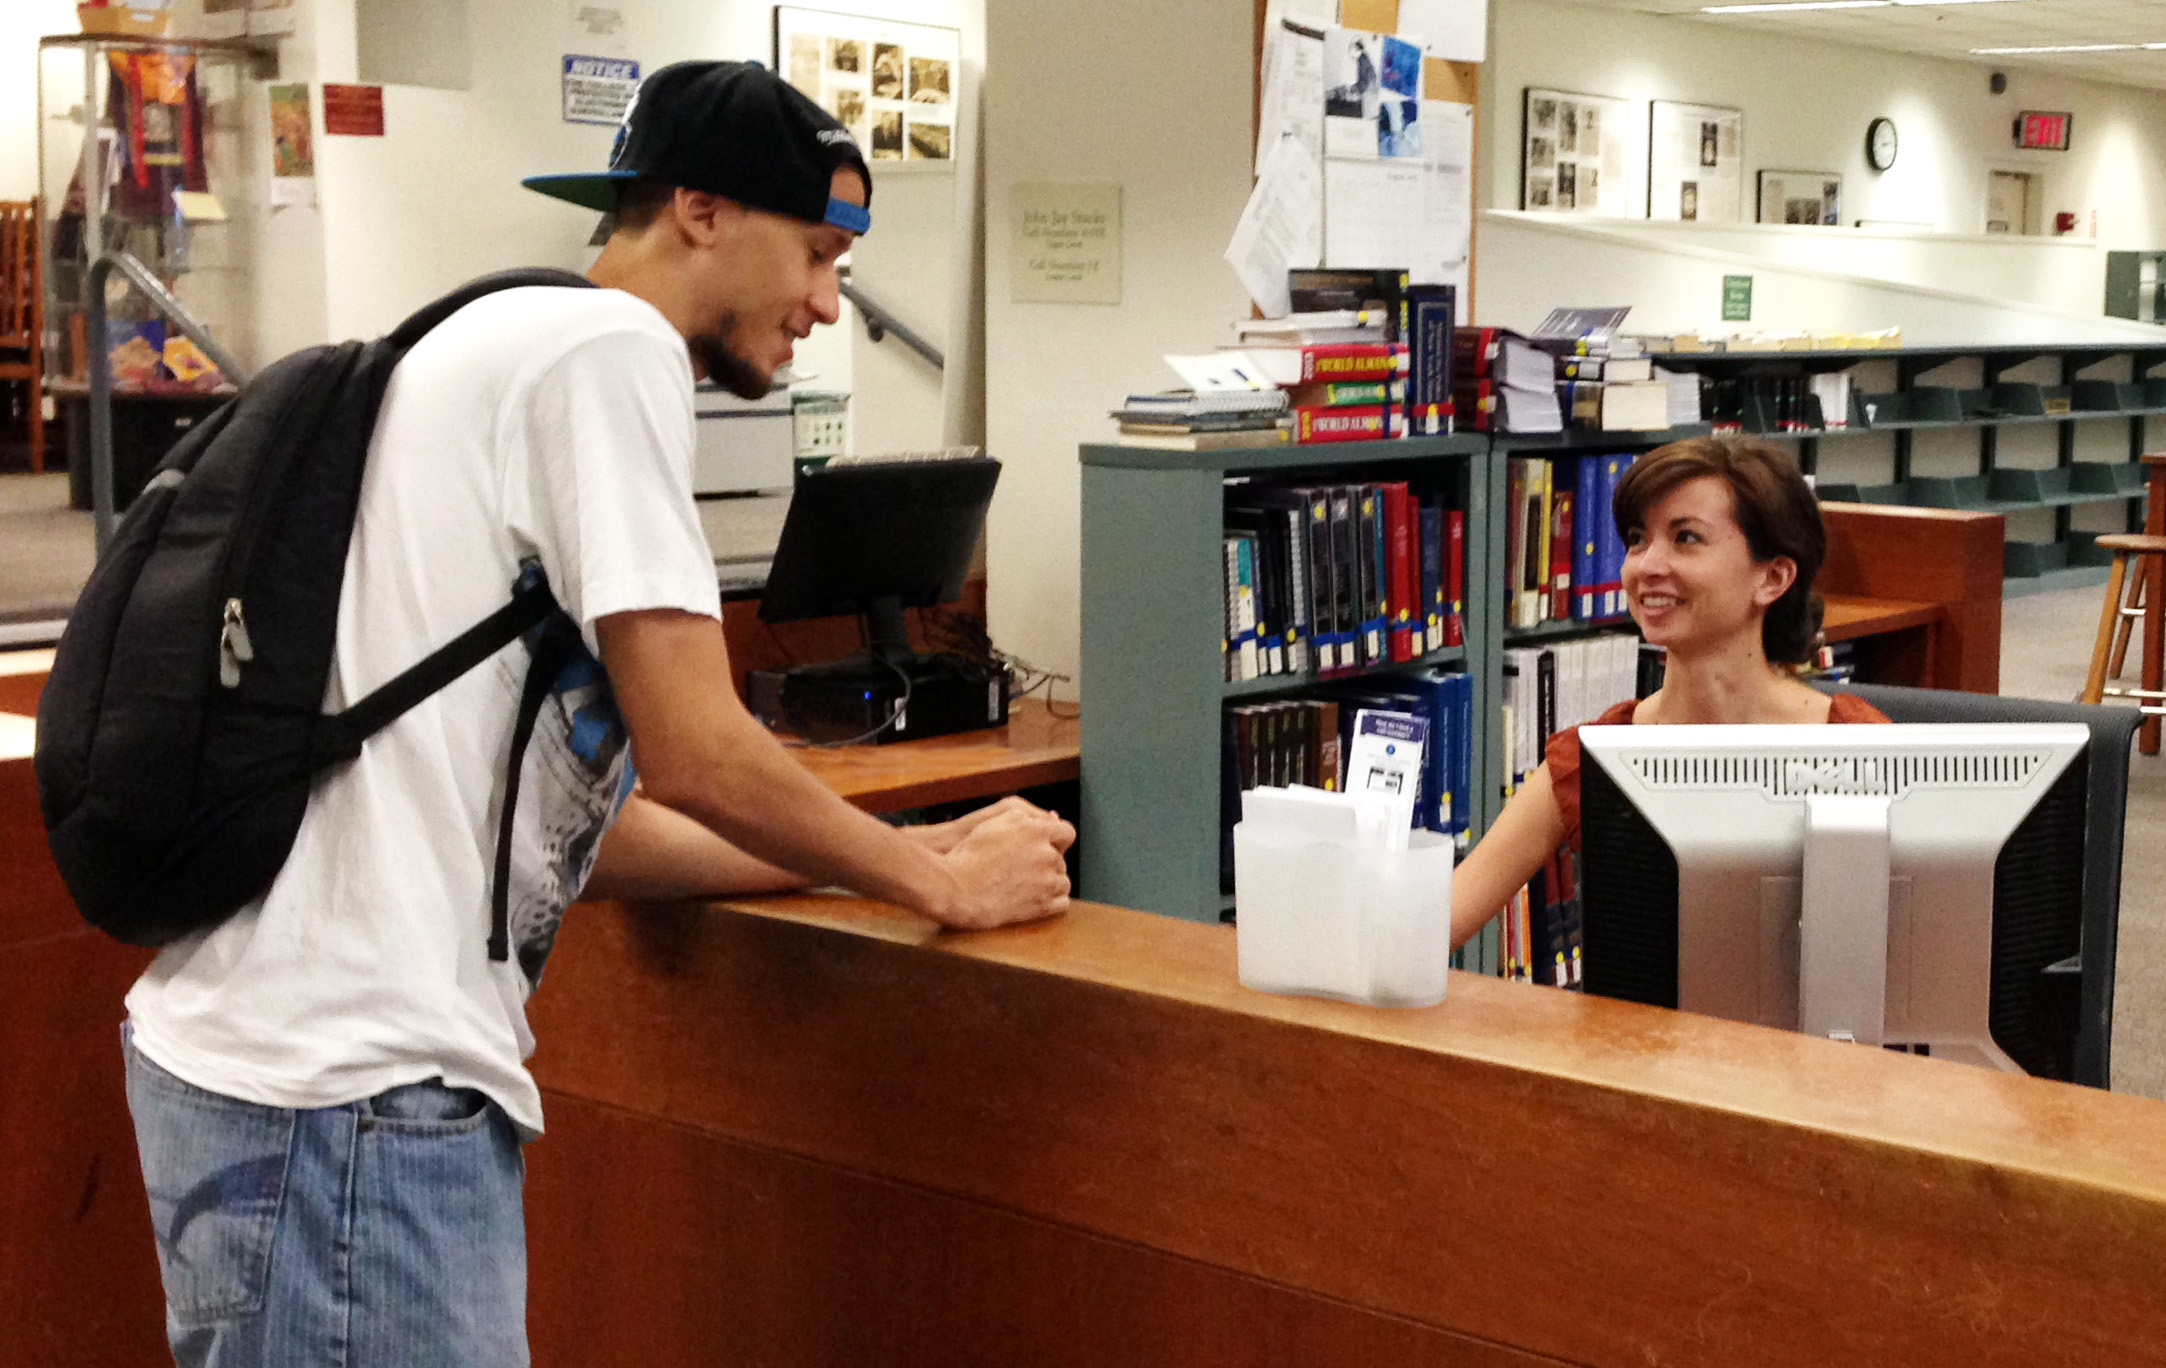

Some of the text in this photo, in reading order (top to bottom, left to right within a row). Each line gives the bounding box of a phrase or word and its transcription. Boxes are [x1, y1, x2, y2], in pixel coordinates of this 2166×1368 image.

[569, 60, 633, 79] NOTICE
[1321, 356, 1354, 373] WORLD
[1317, 416, 1350, 432] WORLD
